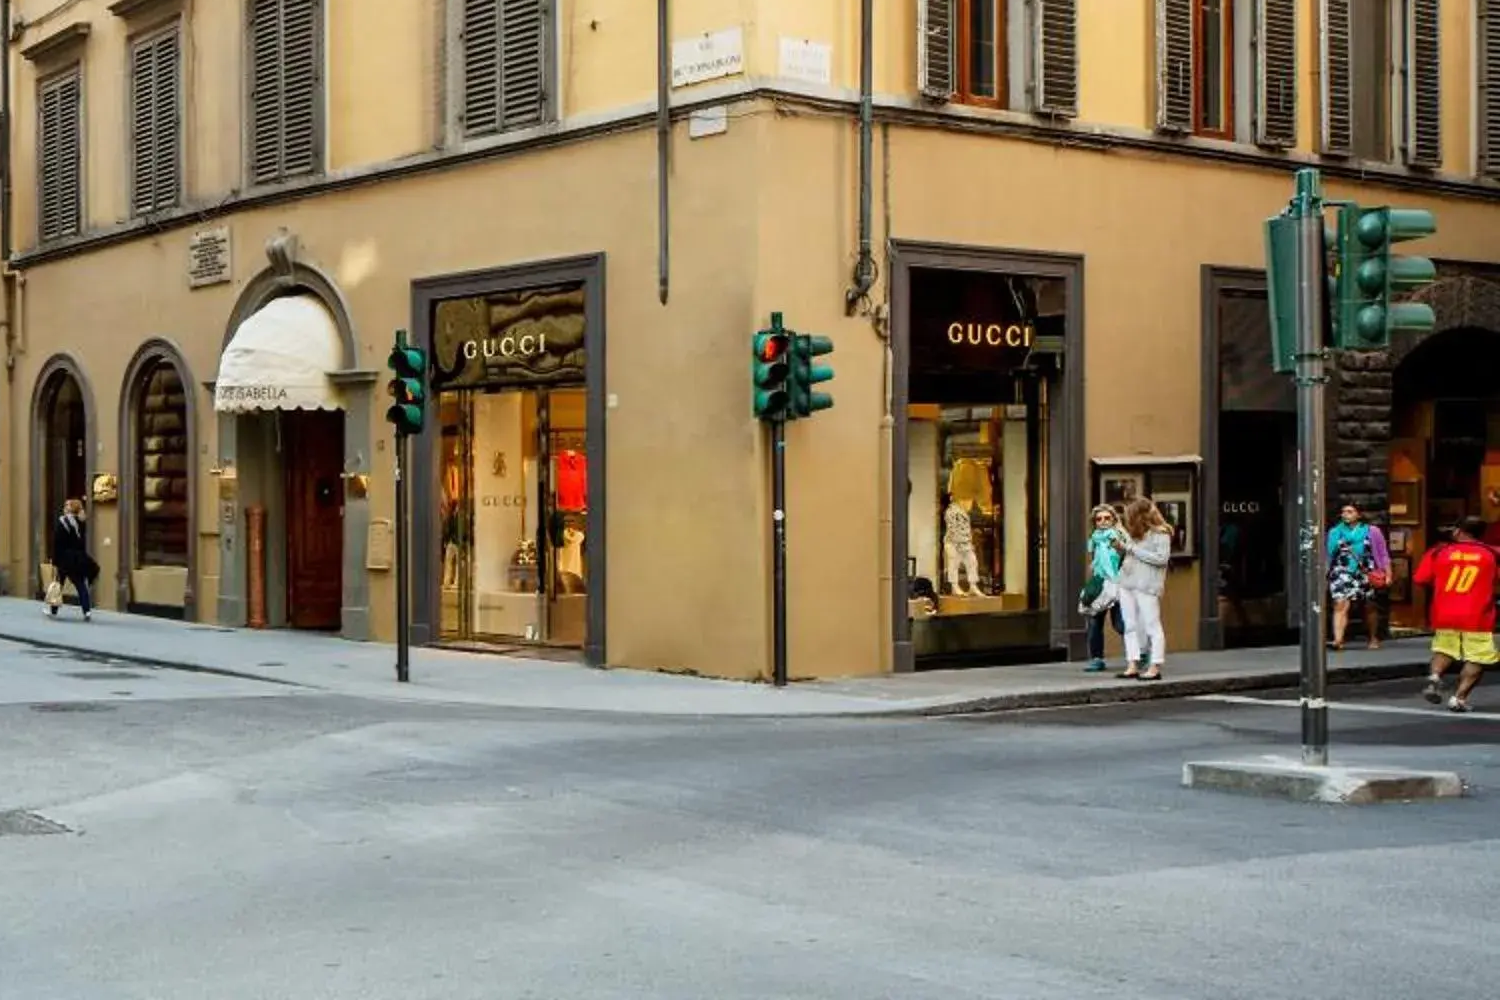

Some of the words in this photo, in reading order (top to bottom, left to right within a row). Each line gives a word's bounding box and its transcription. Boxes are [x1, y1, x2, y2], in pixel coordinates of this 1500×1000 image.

[463, 333, 547, 360] GUCCI
[947, 322, 1032, 348] GUCCI
[1222, 501, 1260, 514] GUCCI
[1443, 563, 1481, 593] 10
